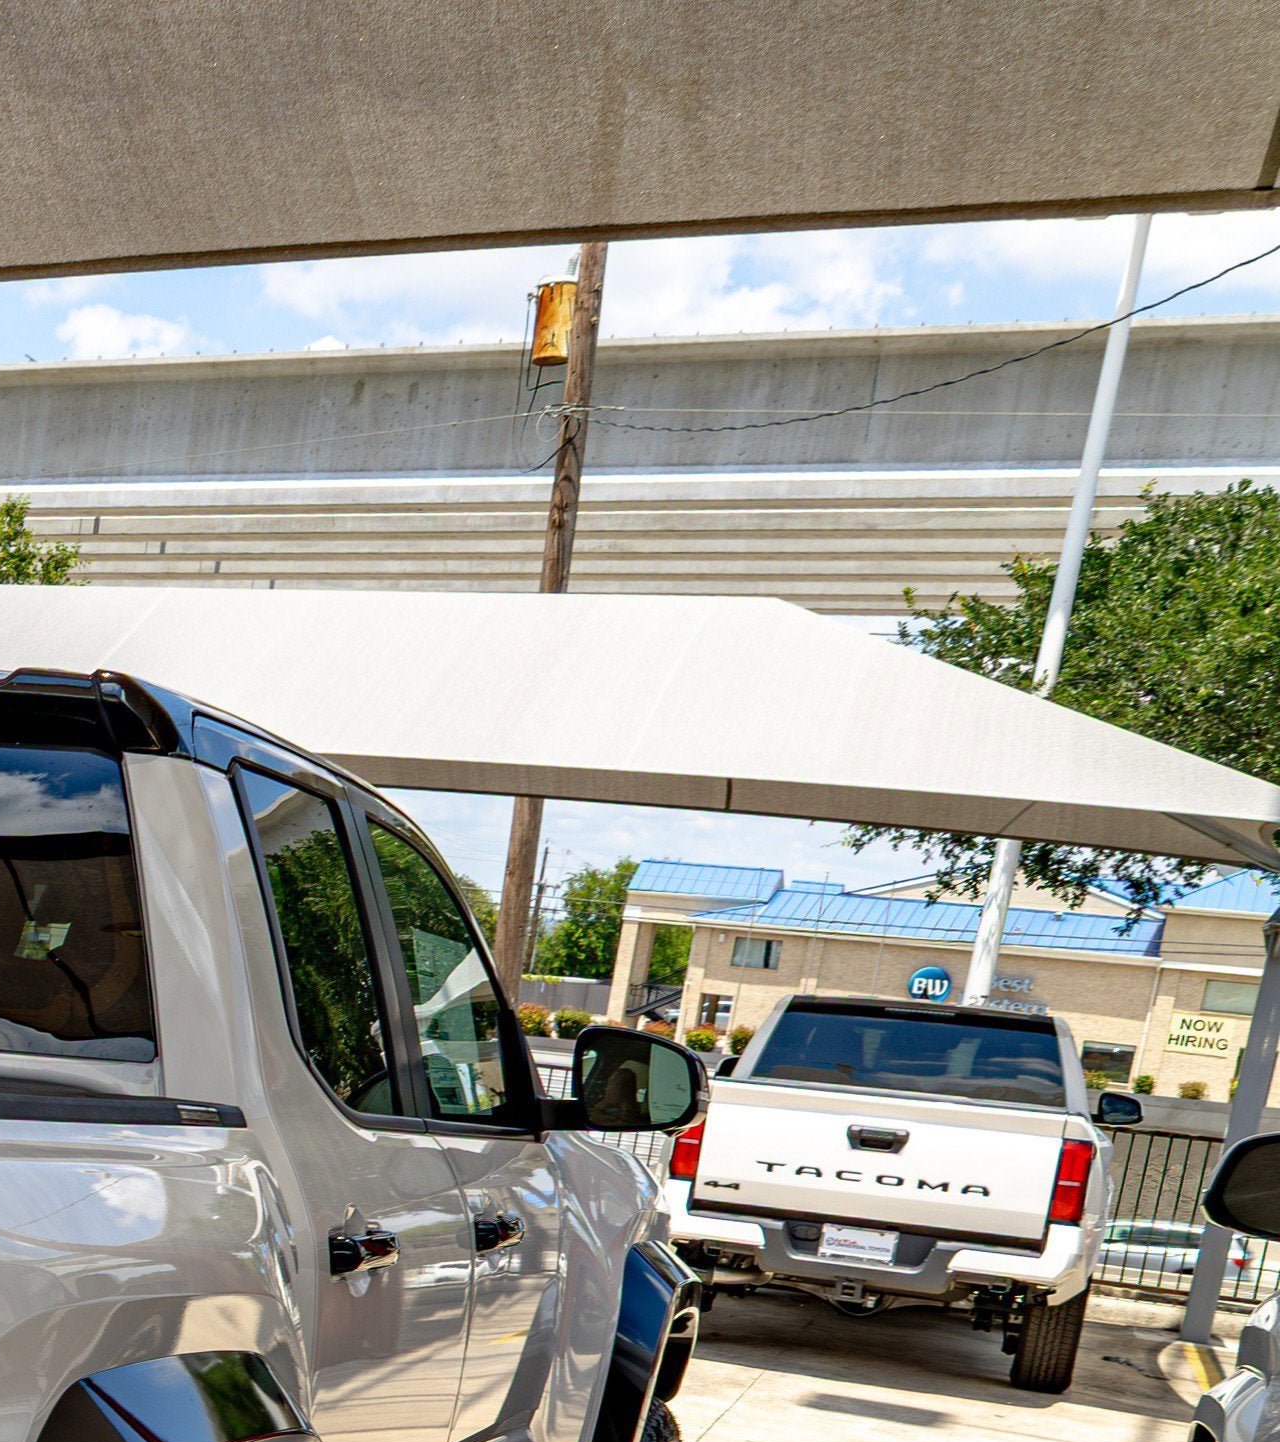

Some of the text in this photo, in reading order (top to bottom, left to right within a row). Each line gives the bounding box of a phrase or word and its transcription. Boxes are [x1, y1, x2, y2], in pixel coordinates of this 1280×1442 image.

[911, 977, 949, 996] BW
[1179, 1018, 1224, 1033] NOW
[1167, 1034, 1229, 1051] HIRING
[756, 1160, 991, 1197] TACOMA
